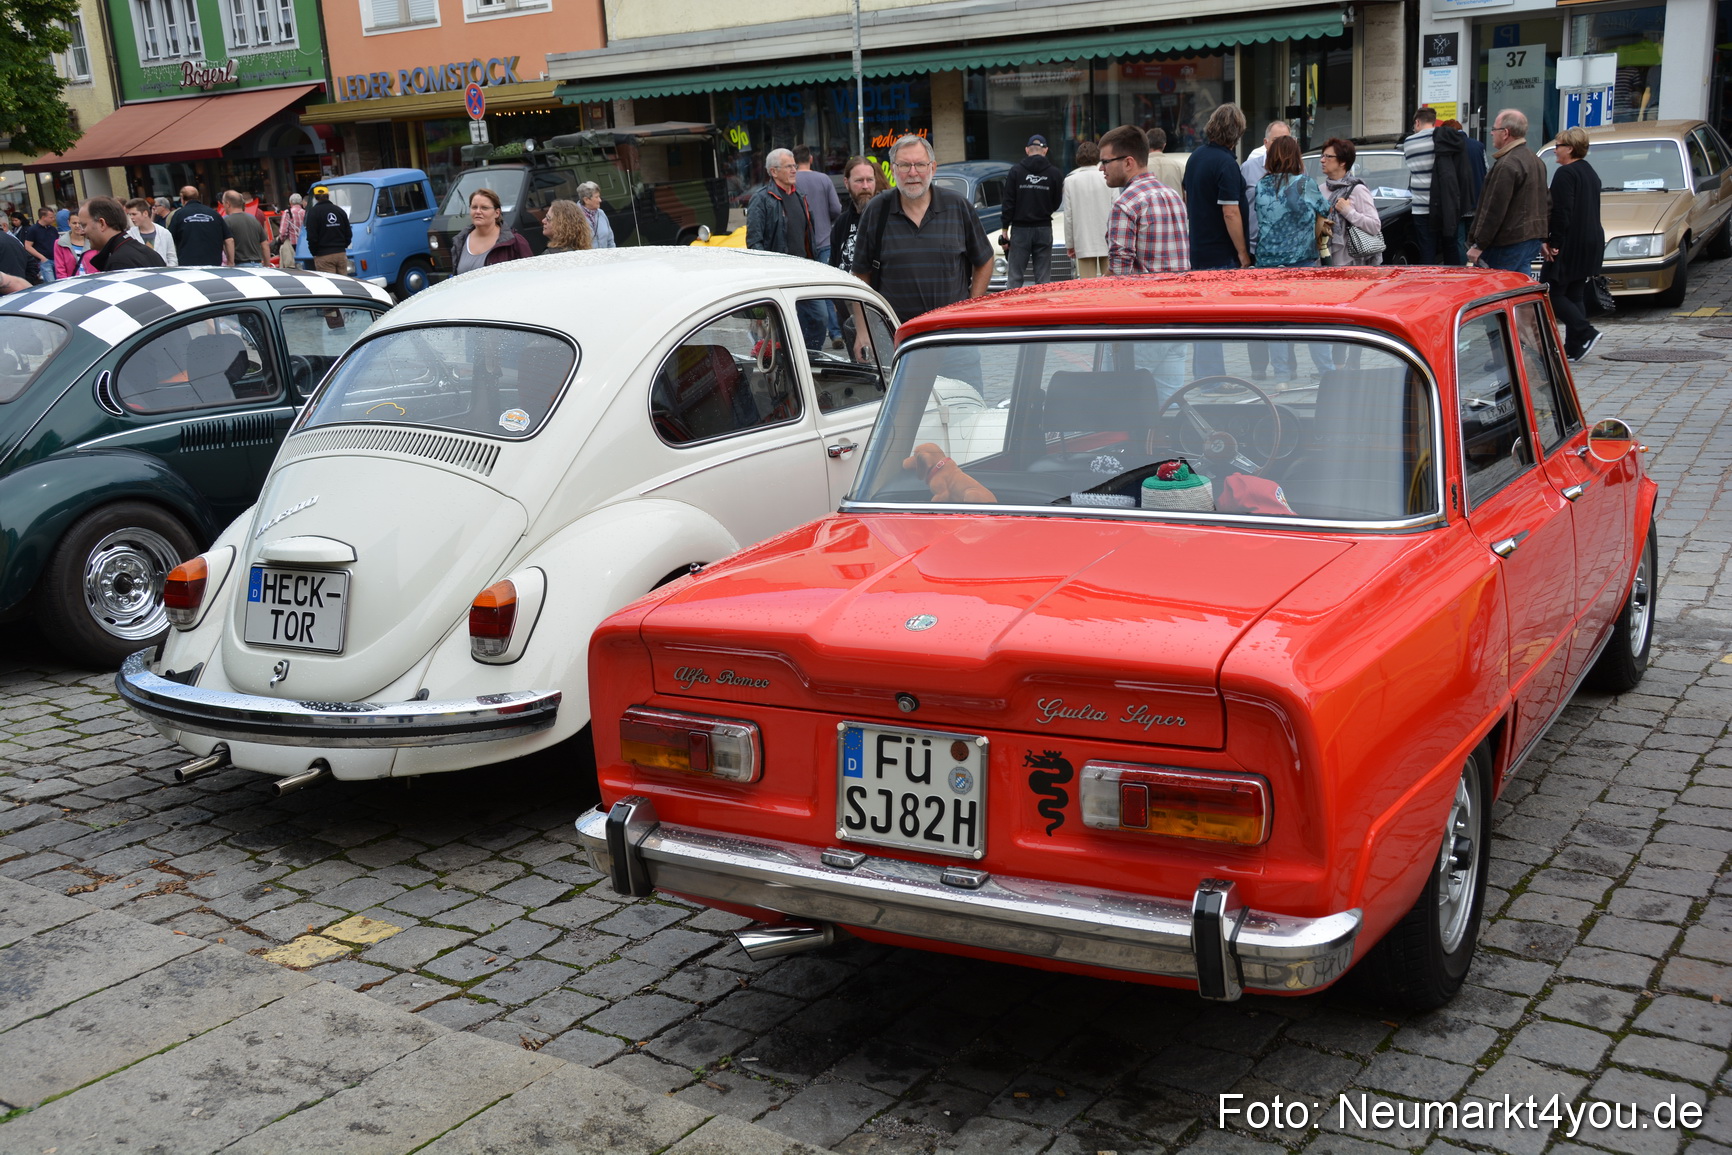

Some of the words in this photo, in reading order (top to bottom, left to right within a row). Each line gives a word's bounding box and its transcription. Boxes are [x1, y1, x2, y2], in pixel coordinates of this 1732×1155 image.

[180, 59, 238, 90] Bögerl
[1505, 51, 1527, 68] 37
[338, 72, 394, 101] LEDER
[398, 56, 520, 96] ROMSTÖCK
[728, 92, 804, 121] JEANS
[1572, 92, 1599, 102] HER
[252, 589, 258, 598] D
[262, 573, 341, 608] HECK-
[270, 609, 316, 643] TOR
[673, 666, 711, 690] Alfa
[715, 669, 770, 688] Romeo
[1036, 698, 1109, 724] Giulia
[1119, 704, 1187, 731] Super
[848, 758, 857, 771] D
[876, 734, 932, 785] FÜ
[845, 785, 977, 847] SJ82H
